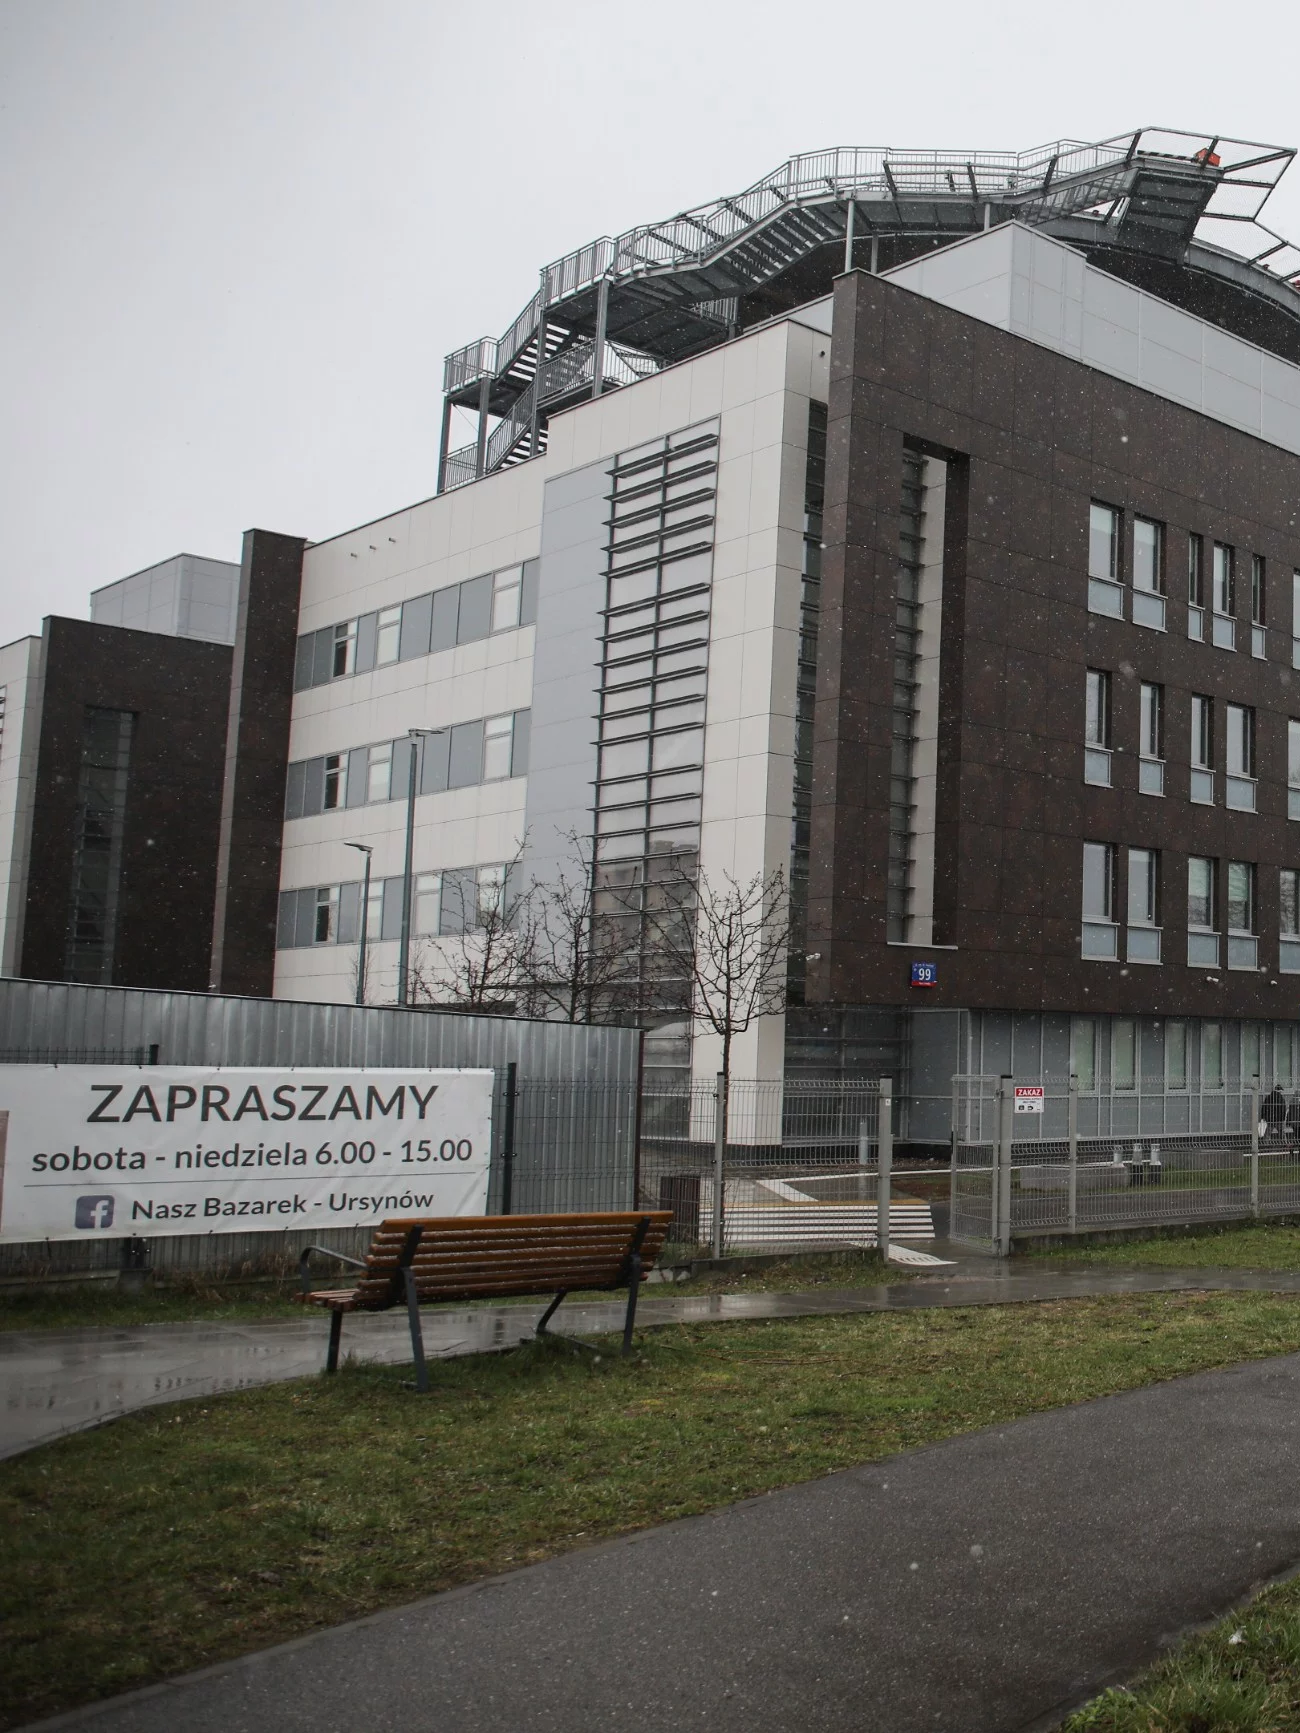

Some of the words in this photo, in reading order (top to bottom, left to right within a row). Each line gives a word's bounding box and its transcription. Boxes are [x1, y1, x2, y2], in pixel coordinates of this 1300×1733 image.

[918, 968, 931, 981] 99
[86, 1084, 440, 1123] ZAPRASZAMY
[31, 1145, 146, 1173] sobota
[174, 1141, 308, 1170] niedziela
[315, 1140, 376, 1165] 6.00
[400, 1139, 473, 1163] 15.00
[131, 1199, 198, 1221] Nasz
[203, 1193, 308, 1218] Bazarek
[328, 1191, 435, 1214] Ursynów
